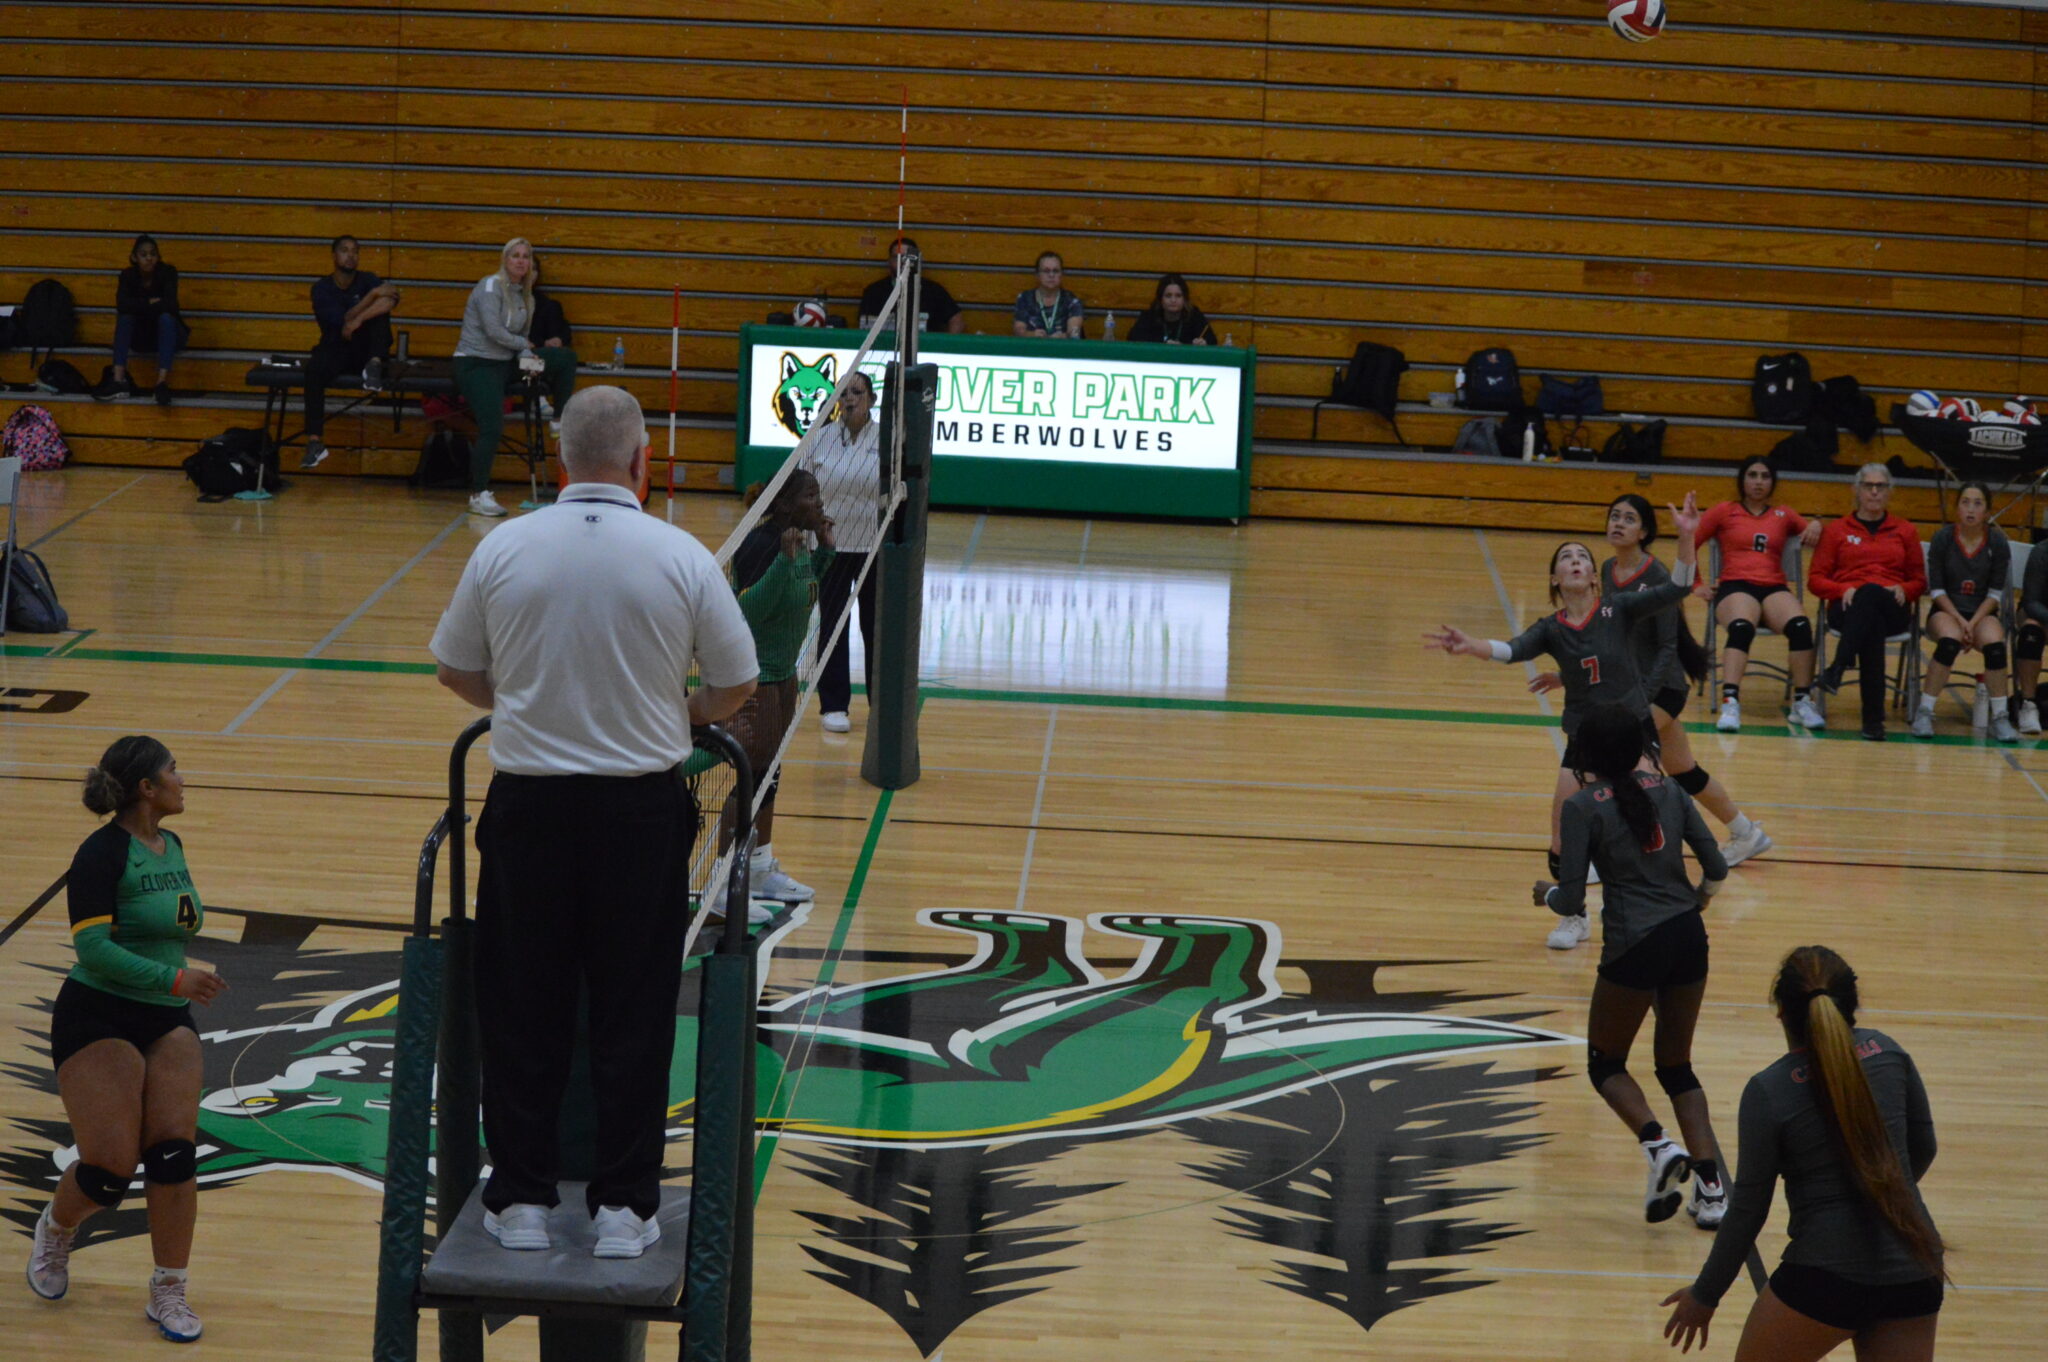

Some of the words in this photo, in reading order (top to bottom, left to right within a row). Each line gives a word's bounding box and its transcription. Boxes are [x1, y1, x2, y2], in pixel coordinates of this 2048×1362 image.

[1073, 373, 1215, 424] PARK
[936, 420, 1174, 453] MBERWOLVES
[1753, 534, 1768, 553] 6
[1580, 655, 1601, 685] 7
[141, 871, 182, 892] CLOVER
[177, 893, 198, 930] 4
